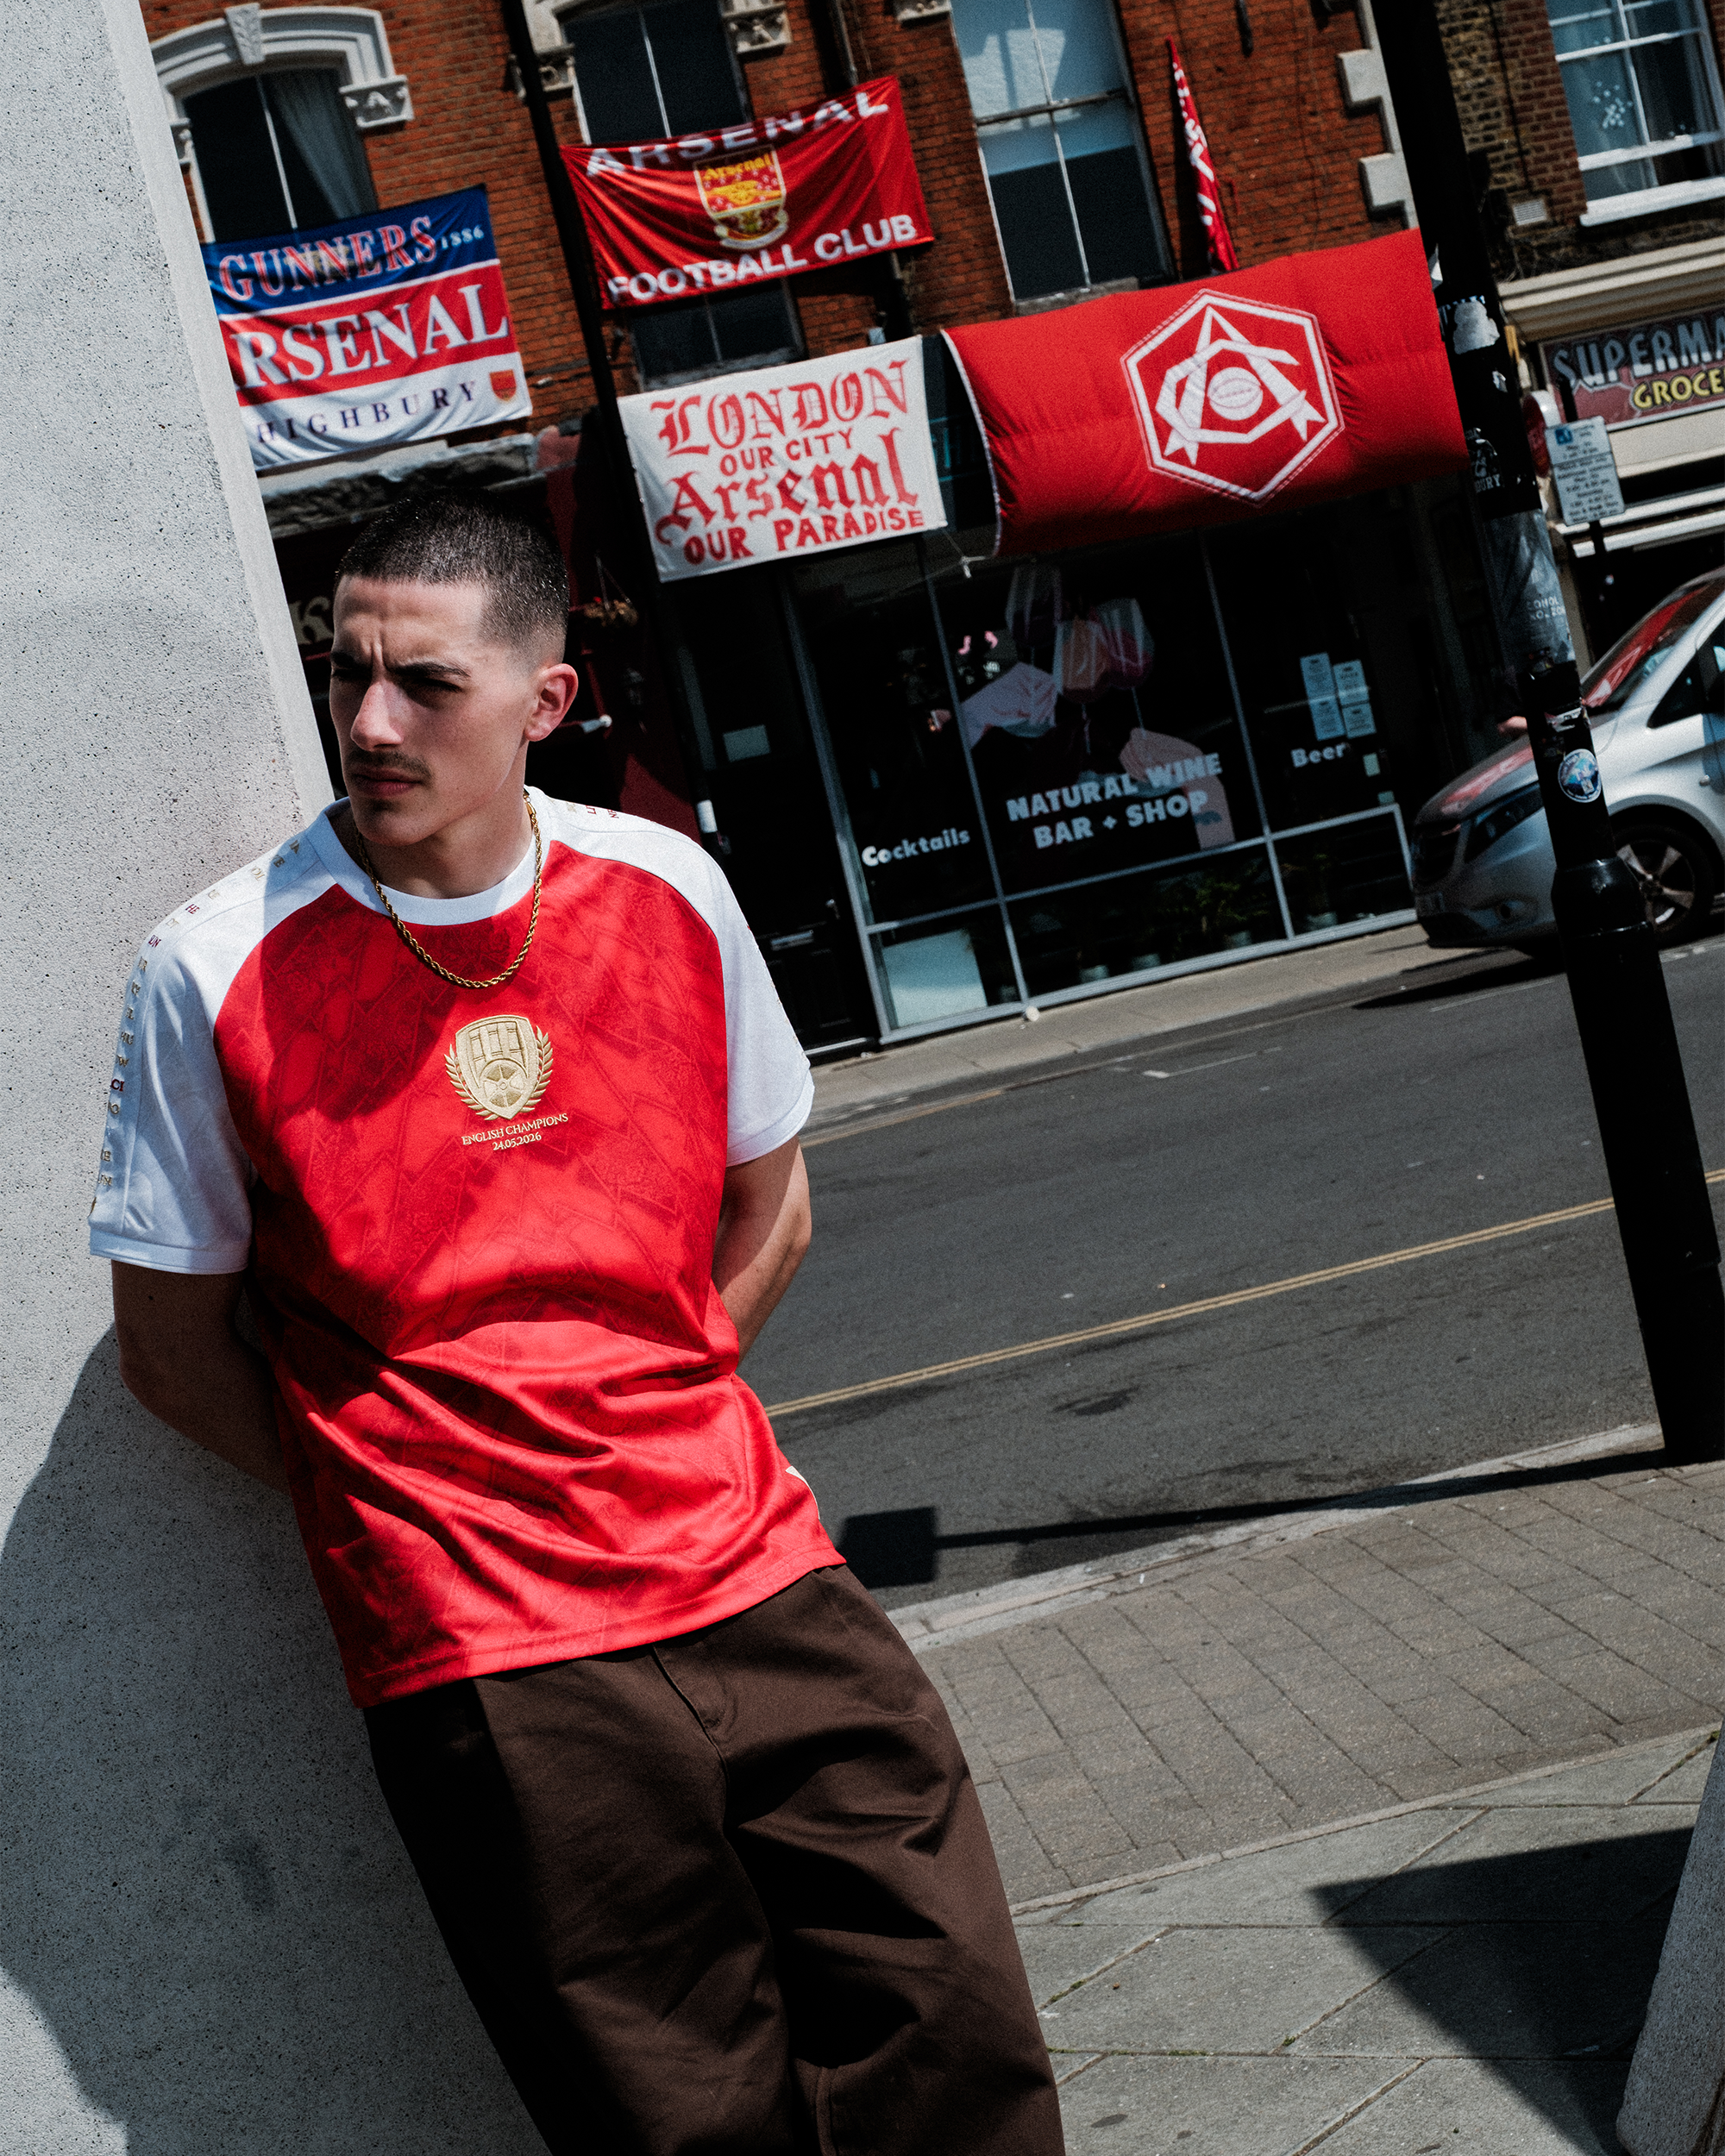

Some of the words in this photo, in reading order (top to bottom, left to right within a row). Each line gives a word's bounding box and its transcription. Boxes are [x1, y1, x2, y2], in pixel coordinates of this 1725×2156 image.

[218, 215, 437, 302] GUNNERS
[441, 225, 485, 249] 1886
[607, 243, 807, 302] FOOTBALL
[814, 215, 917, 260] CLUB
[229, 283, 510, 392] RSENAL
[649, 356, 911, 459] LONDON
[1633, 368, 1725, 410] GROCE
[719, 445, 775, 477] OUR
[785, 427, 854, 461] CITY
[654, 426, 919, 547] Arsenal
[683, 526, 754, 566] OUR
[773, 506, 925, 552] PARADISE
[1290, 742, 1349, 768] Beer
[1006, 774, 1140, 823] NATURAL
[1145, 752, 1223, 786] WINE
[862, 827, 971, 867] Cocktails
[1032, 818, 1095, 849] BAR
[1126, 789, 1210, 829] SHOP
[461, 1128, 505, 1146] ENGLISH
[505, 1112, 569, 1134] CHAMPIONS
[492, 1131, 543, 1151] 24.05.2026
